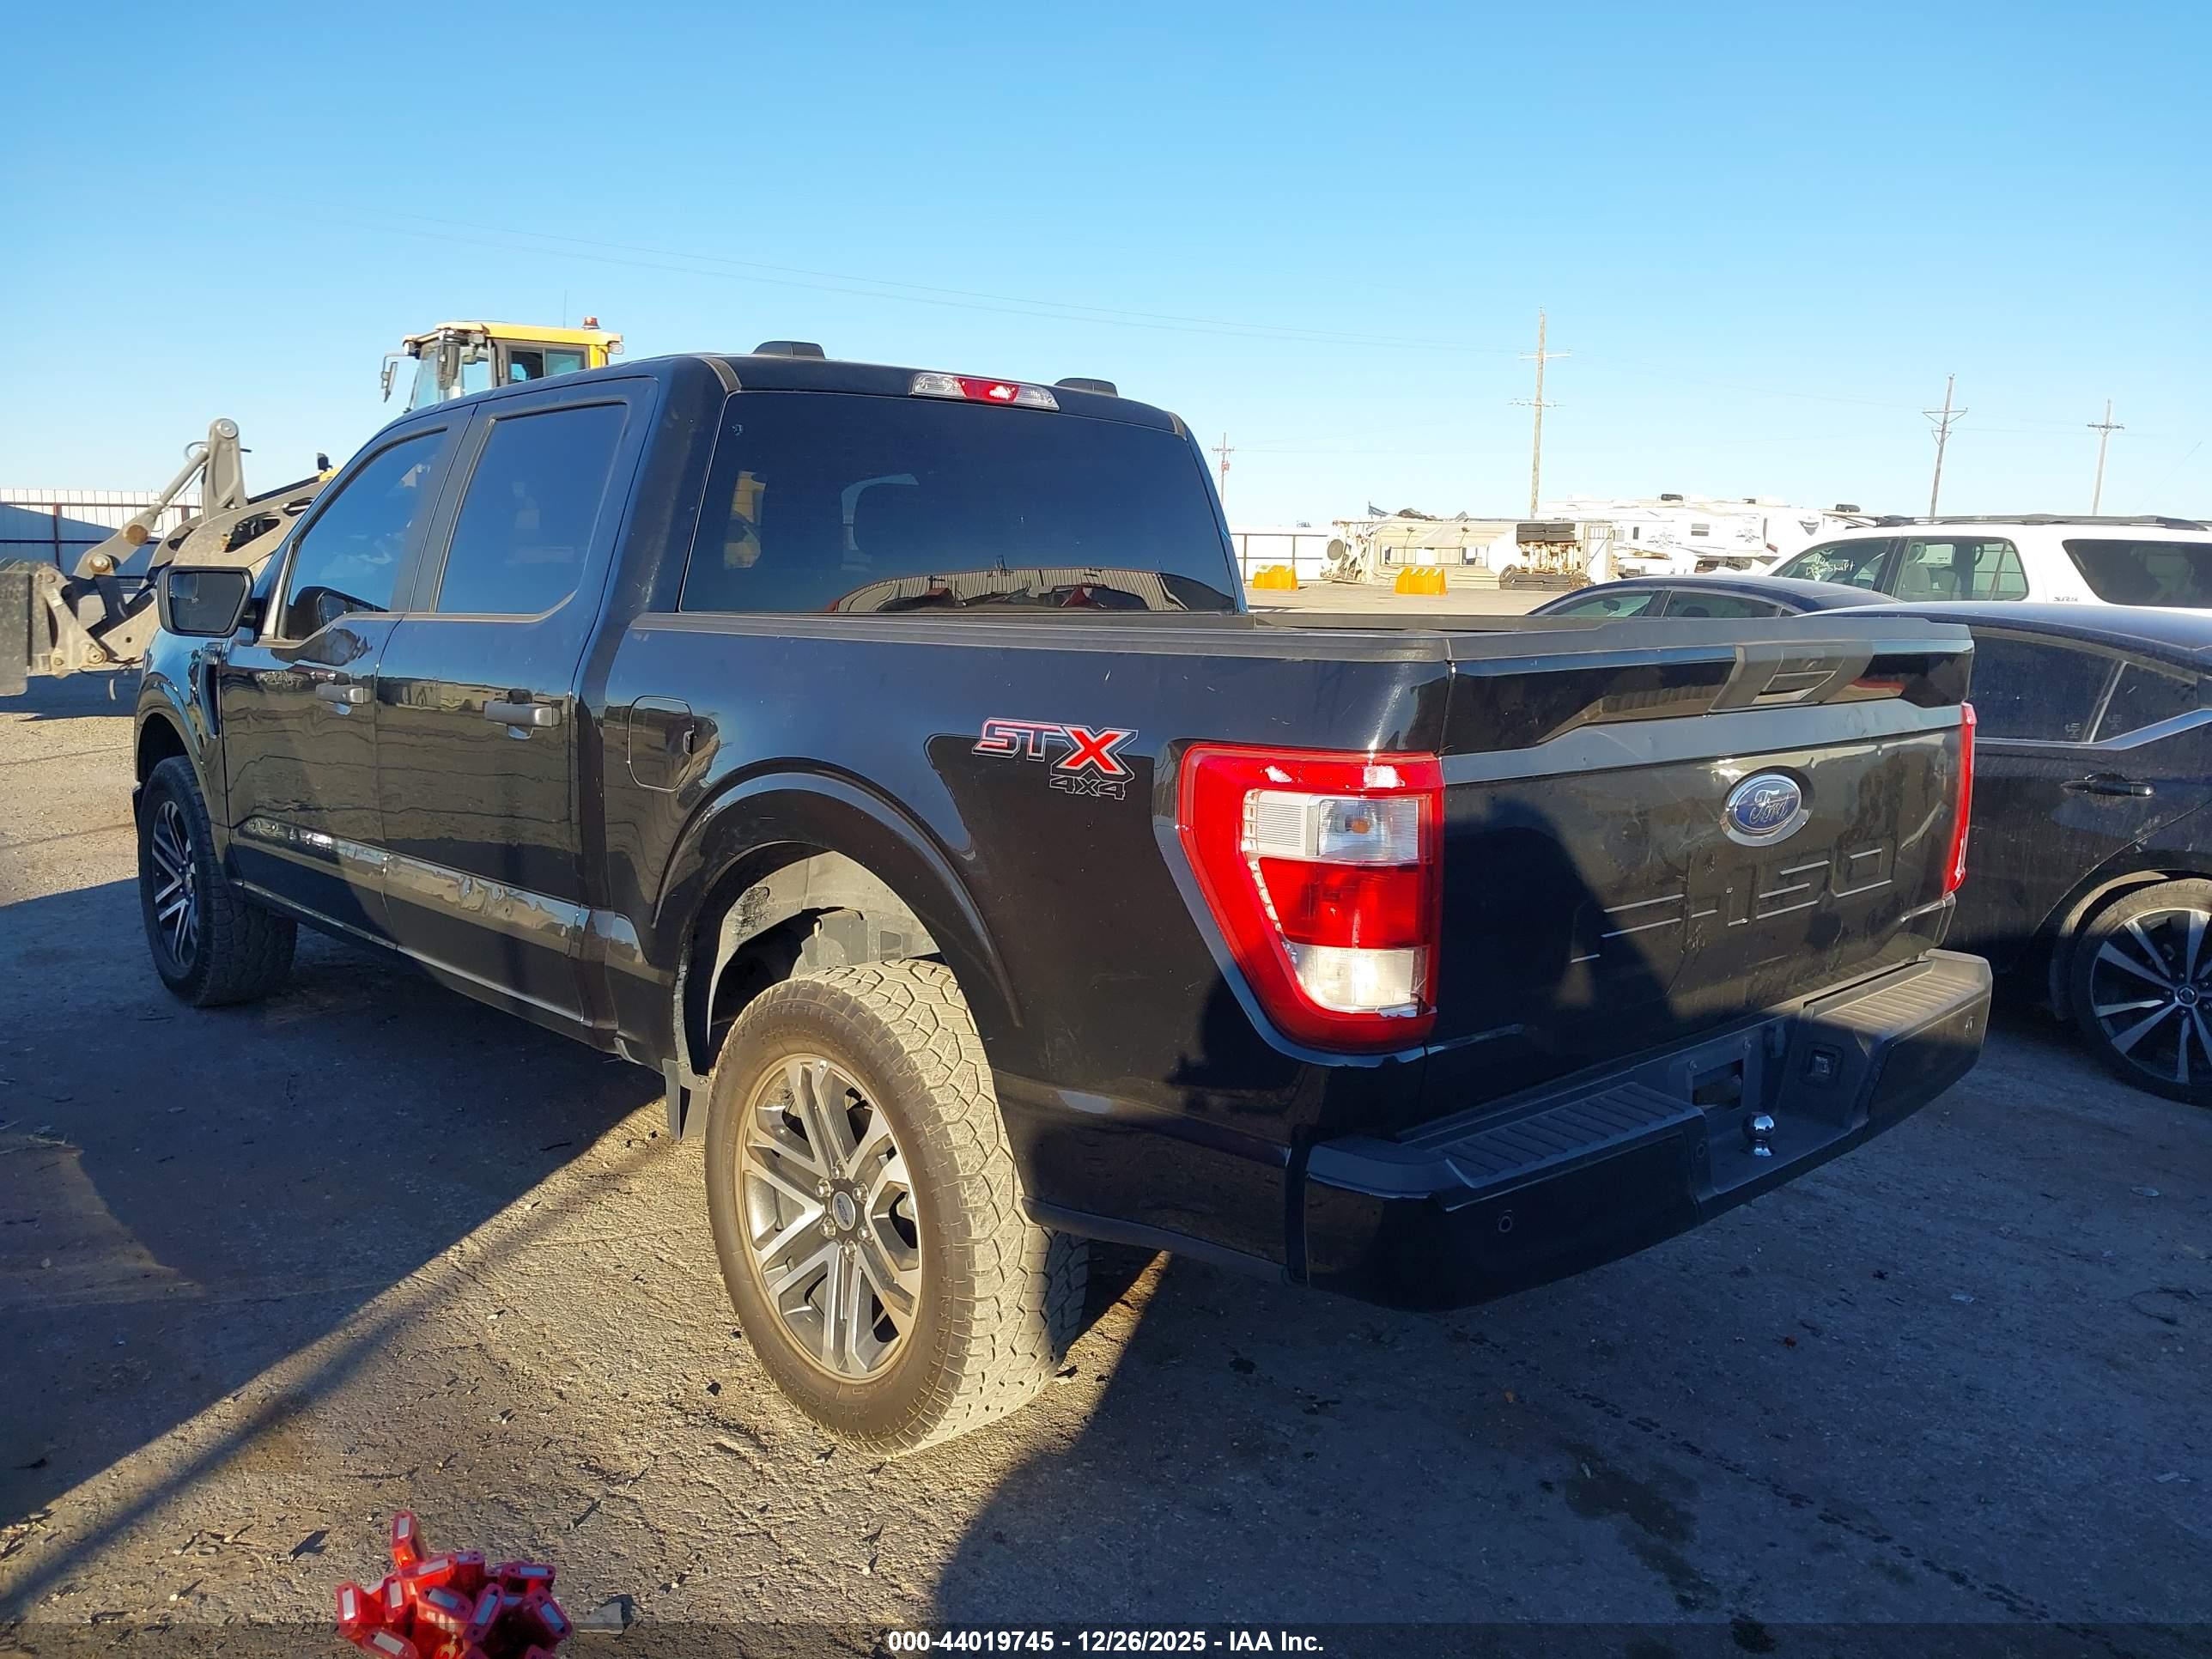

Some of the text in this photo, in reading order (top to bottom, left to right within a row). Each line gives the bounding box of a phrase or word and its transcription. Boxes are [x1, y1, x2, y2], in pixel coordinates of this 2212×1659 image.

[971, 717, 1139, 783] STX
[1749, 789, 1790, 824] Ford
[1571, 840, 1897, 963] F-150
